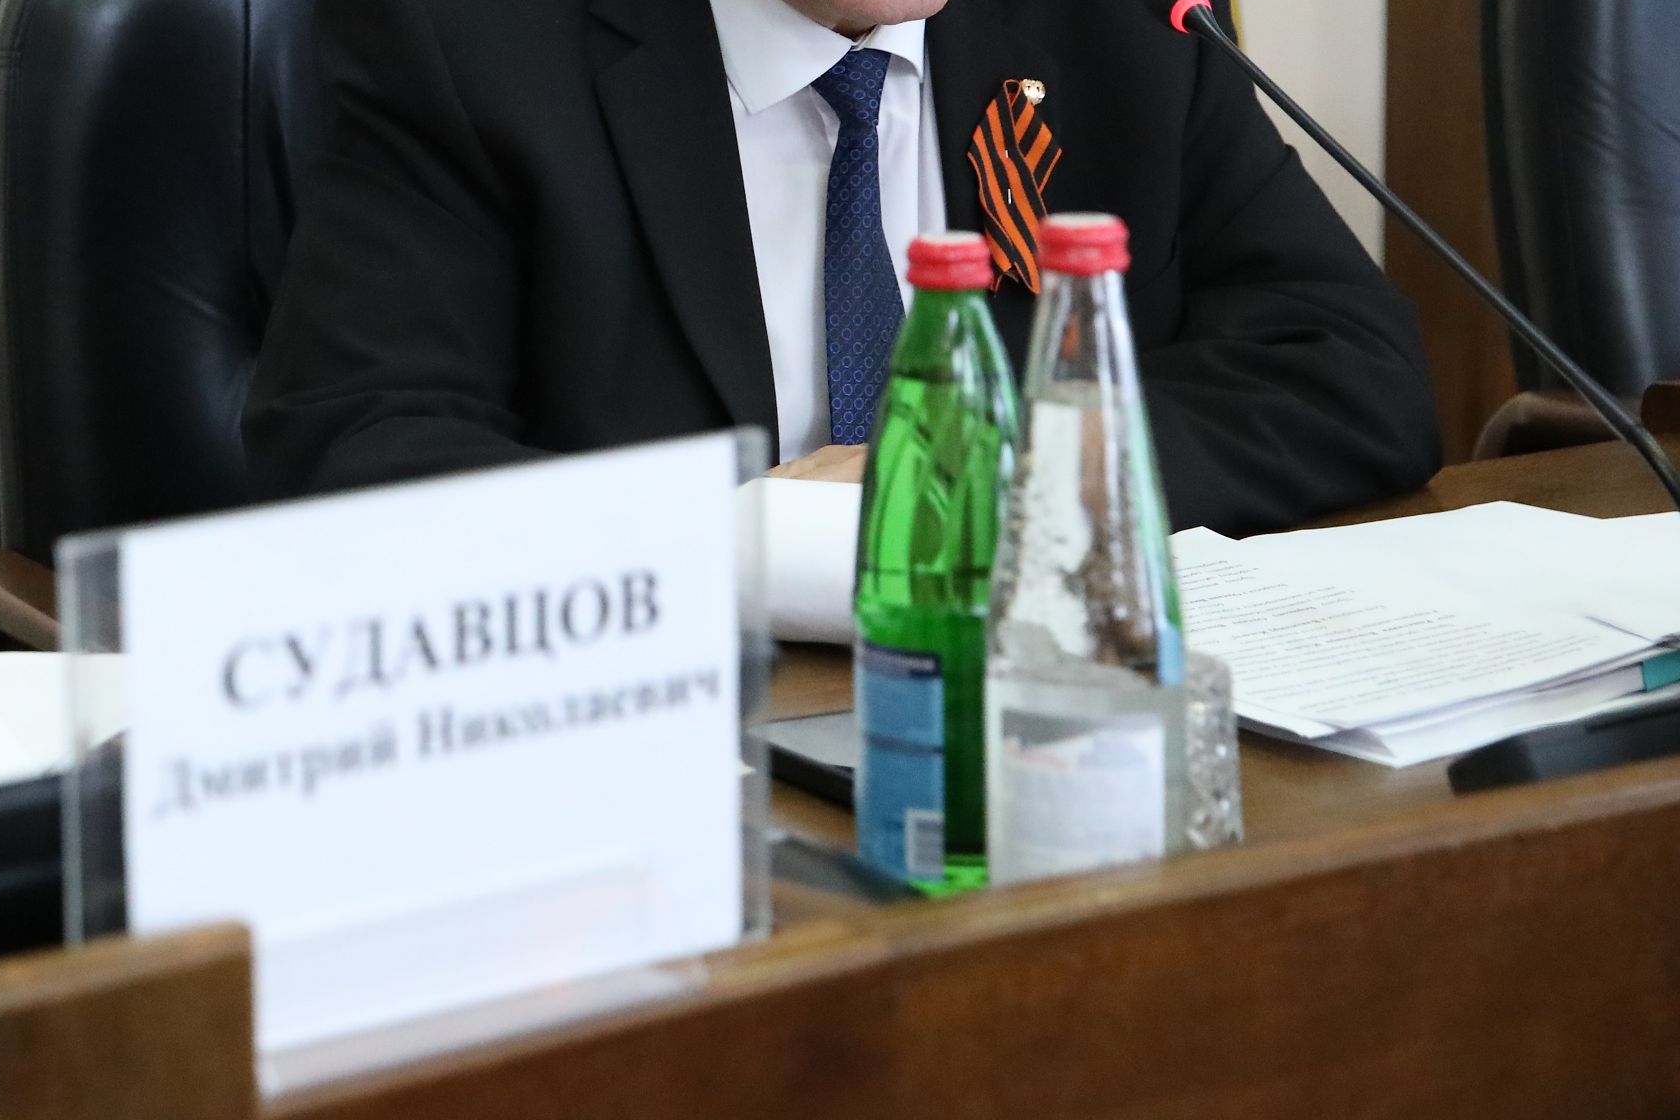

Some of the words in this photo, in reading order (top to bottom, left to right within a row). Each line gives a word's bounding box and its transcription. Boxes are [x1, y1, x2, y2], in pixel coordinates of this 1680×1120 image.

[220, 569, 662, 710] СУДАВЦОВ
[156, 728, 399, 818] Дмитрий
[416, 662, 722, 758] Николаевич
